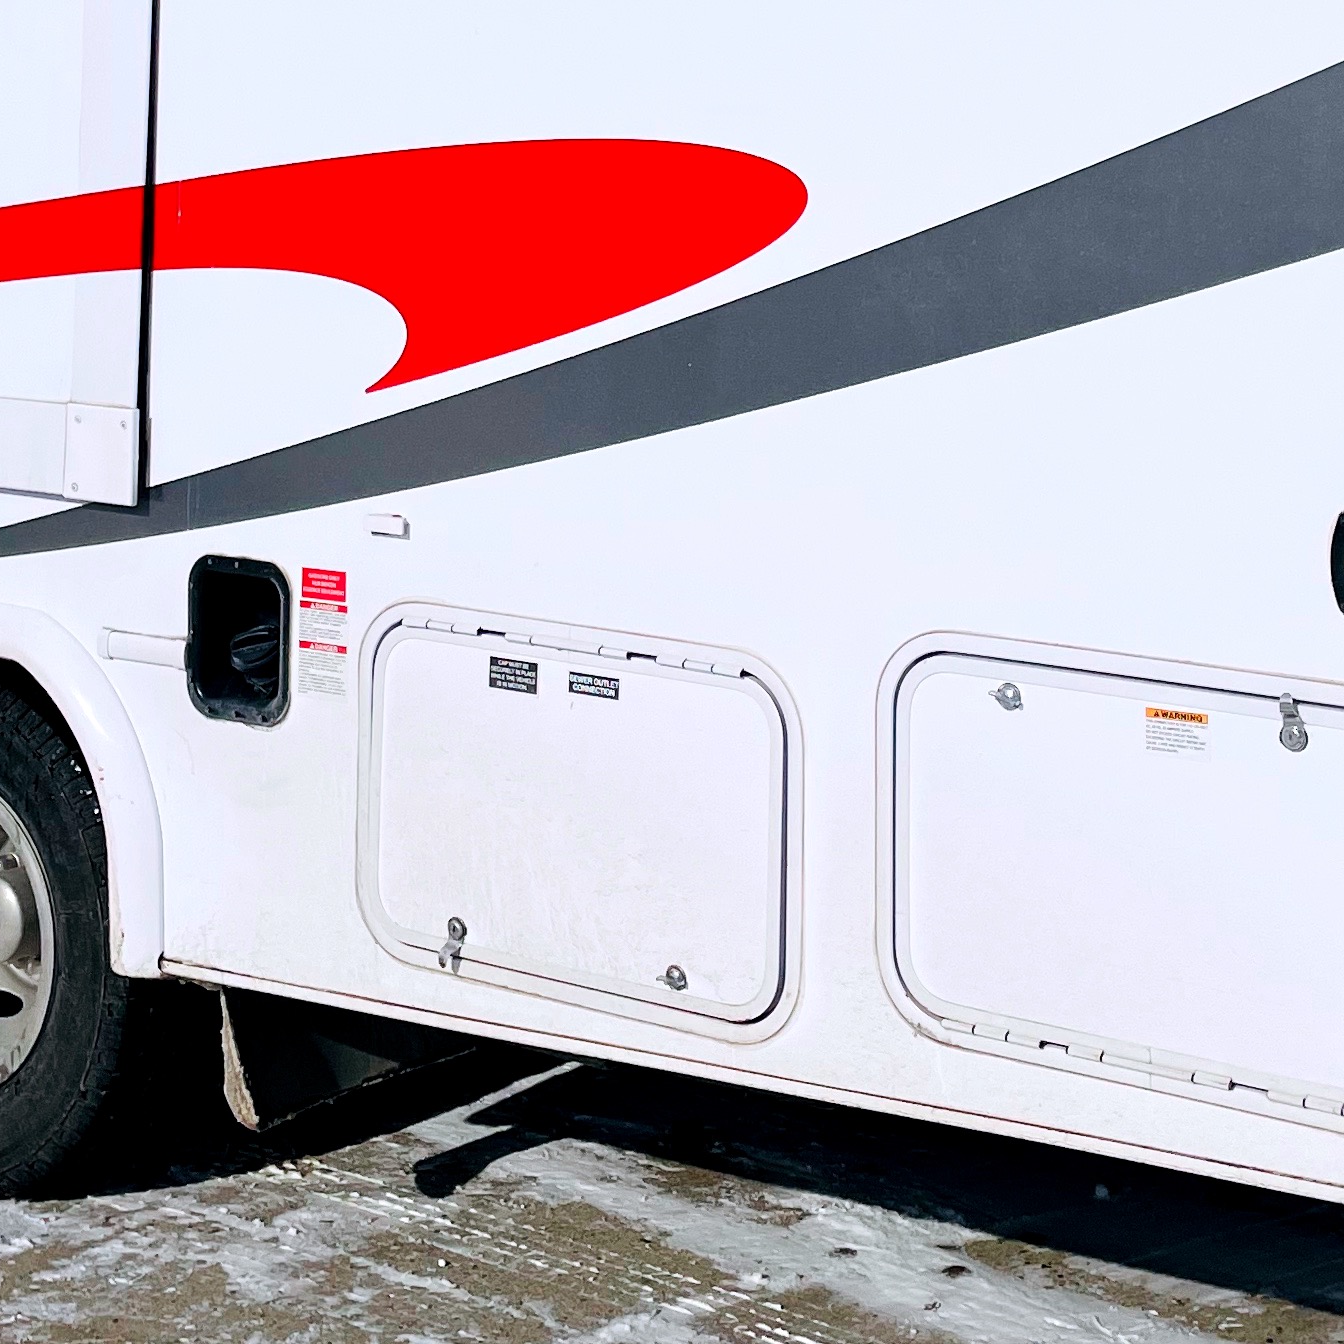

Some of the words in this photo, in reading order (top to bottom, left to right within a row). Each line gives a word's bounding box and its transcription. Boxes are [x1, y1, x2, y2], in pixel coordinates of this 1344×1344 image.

[569, 674, 593, 685] SEWER
[594, 678, 618, 689] OUTLET
[572, 683, 615, 697] CONNECTION
[1161, 710, 1203, 722] WARNING
